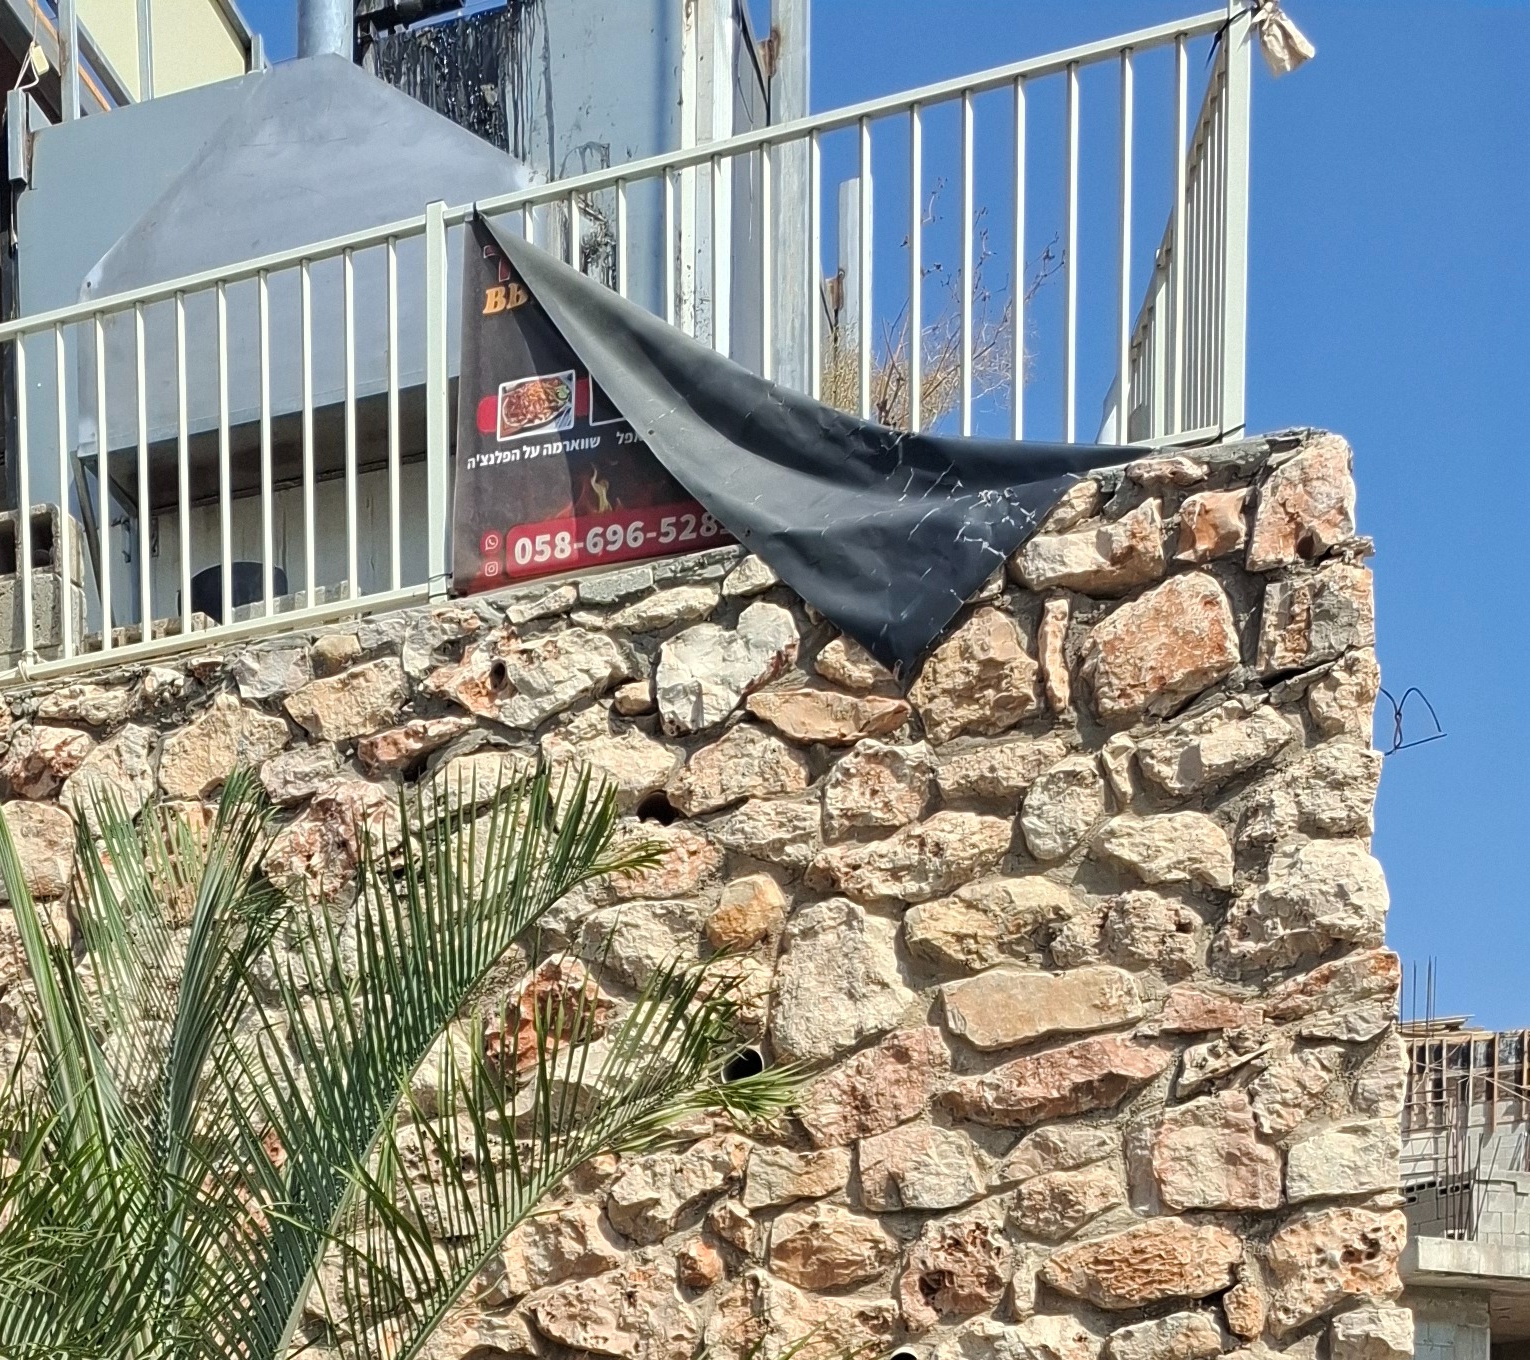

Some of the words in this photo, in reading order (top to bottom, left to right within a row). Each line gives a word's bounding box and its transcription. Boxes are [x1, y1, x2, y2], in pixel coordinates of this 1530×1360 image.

[522, 445, 541, 460] על
[542, 435, 601, 456] שווארמה
[514, 512, 730, 565] 058-696-528
